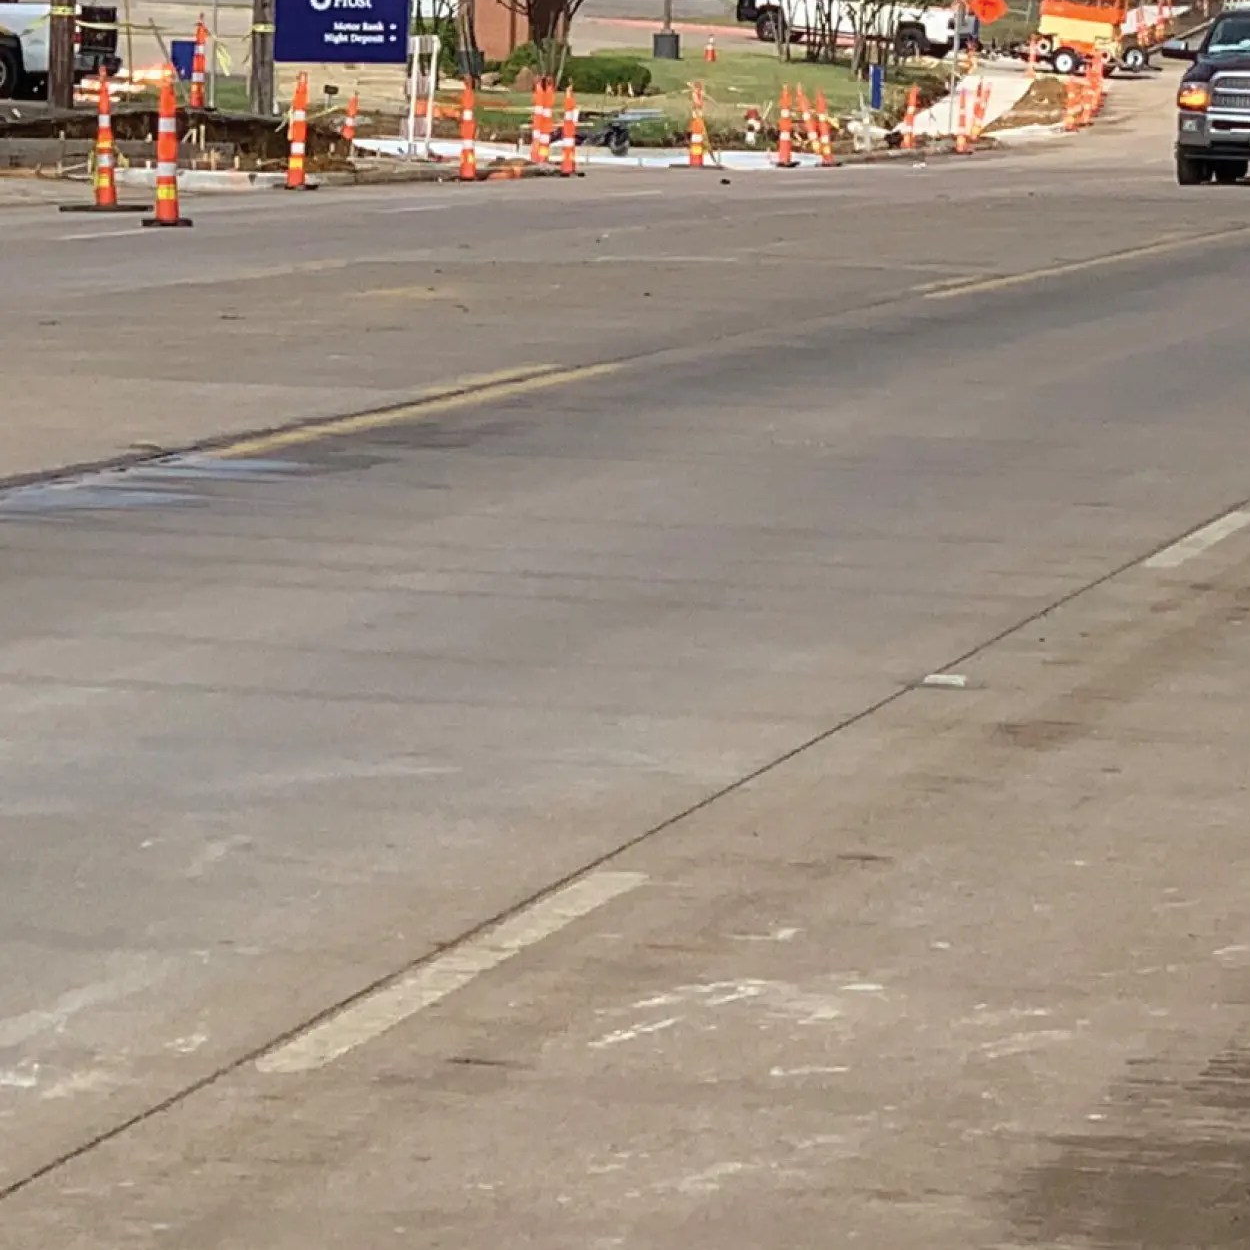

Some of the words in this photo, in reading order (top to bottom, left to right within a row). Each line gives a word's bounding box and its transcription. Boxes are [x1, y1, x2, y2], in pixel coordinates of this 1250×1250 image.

[333, 21, 361, 31] Motor
[362, 21, 384, 31] Bank
[323, 33, 348, 44] Night
[350, 34, 384, 44] Deposit
